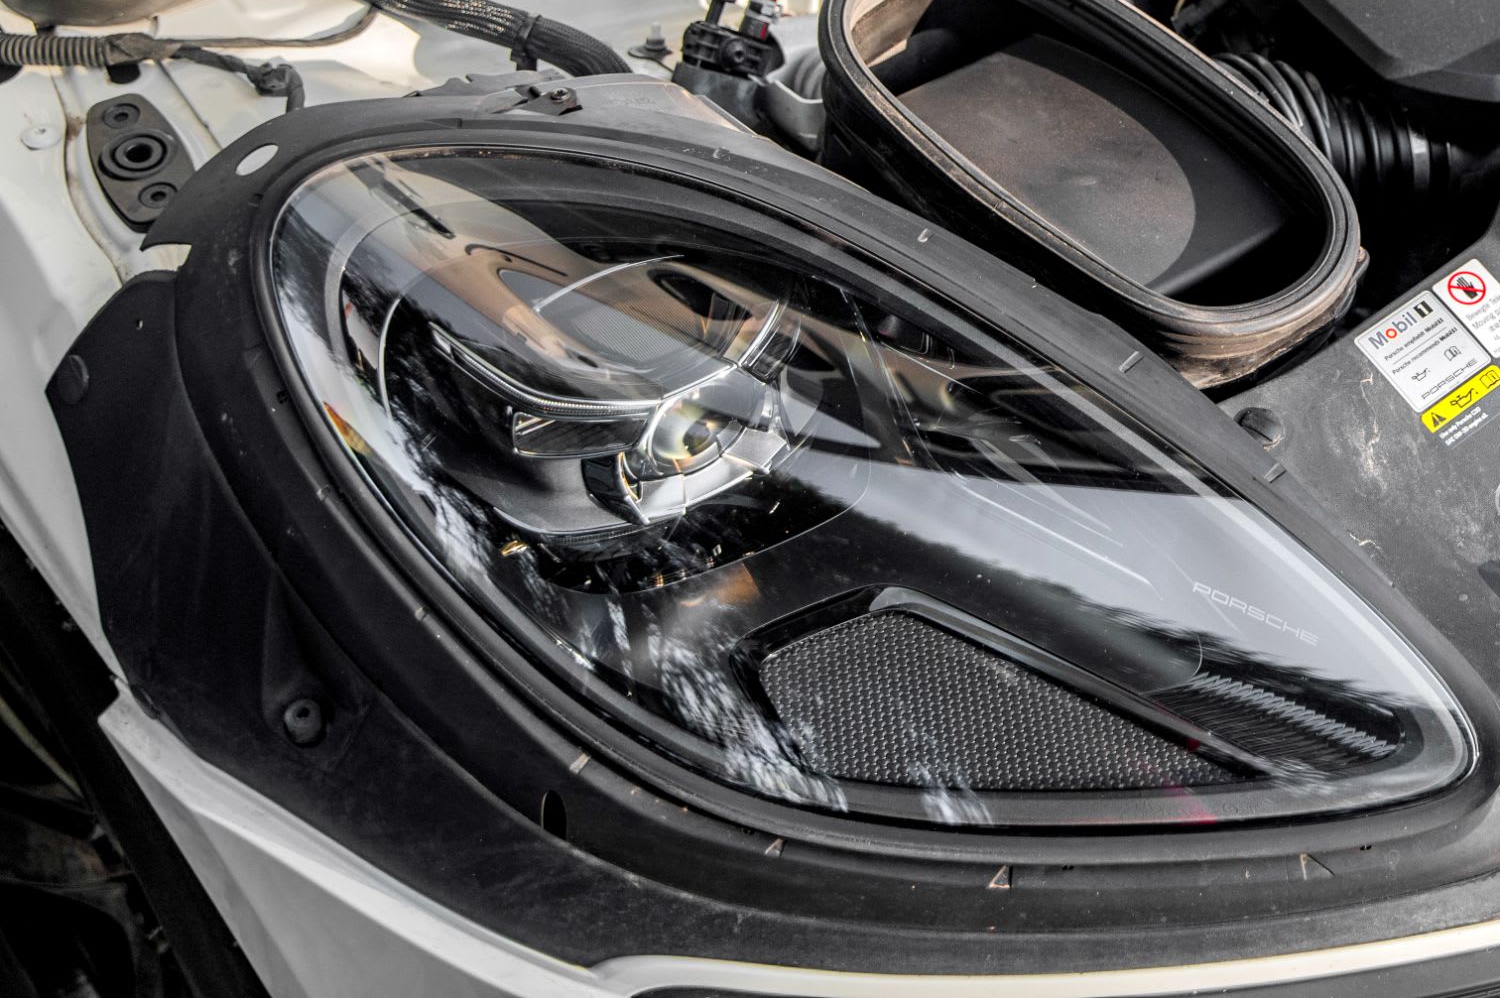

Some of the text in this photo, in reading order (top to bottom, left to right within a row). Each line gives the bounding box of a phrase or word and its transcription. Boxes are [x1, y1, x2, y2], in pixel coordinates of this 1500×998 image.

[1367, 302, 1431, 350] Mobil 1
[1472, 312, 1496, 330] Moving
[1384, 345, 1404, 361] Porsche
[1391, 359, 1412, 375] Porsche
[1411, 340, 1440, 363] recommends
[1421, 357, 1477, 400] PORSCHE
[1192, 581, 1320, 647] PORSCHE
